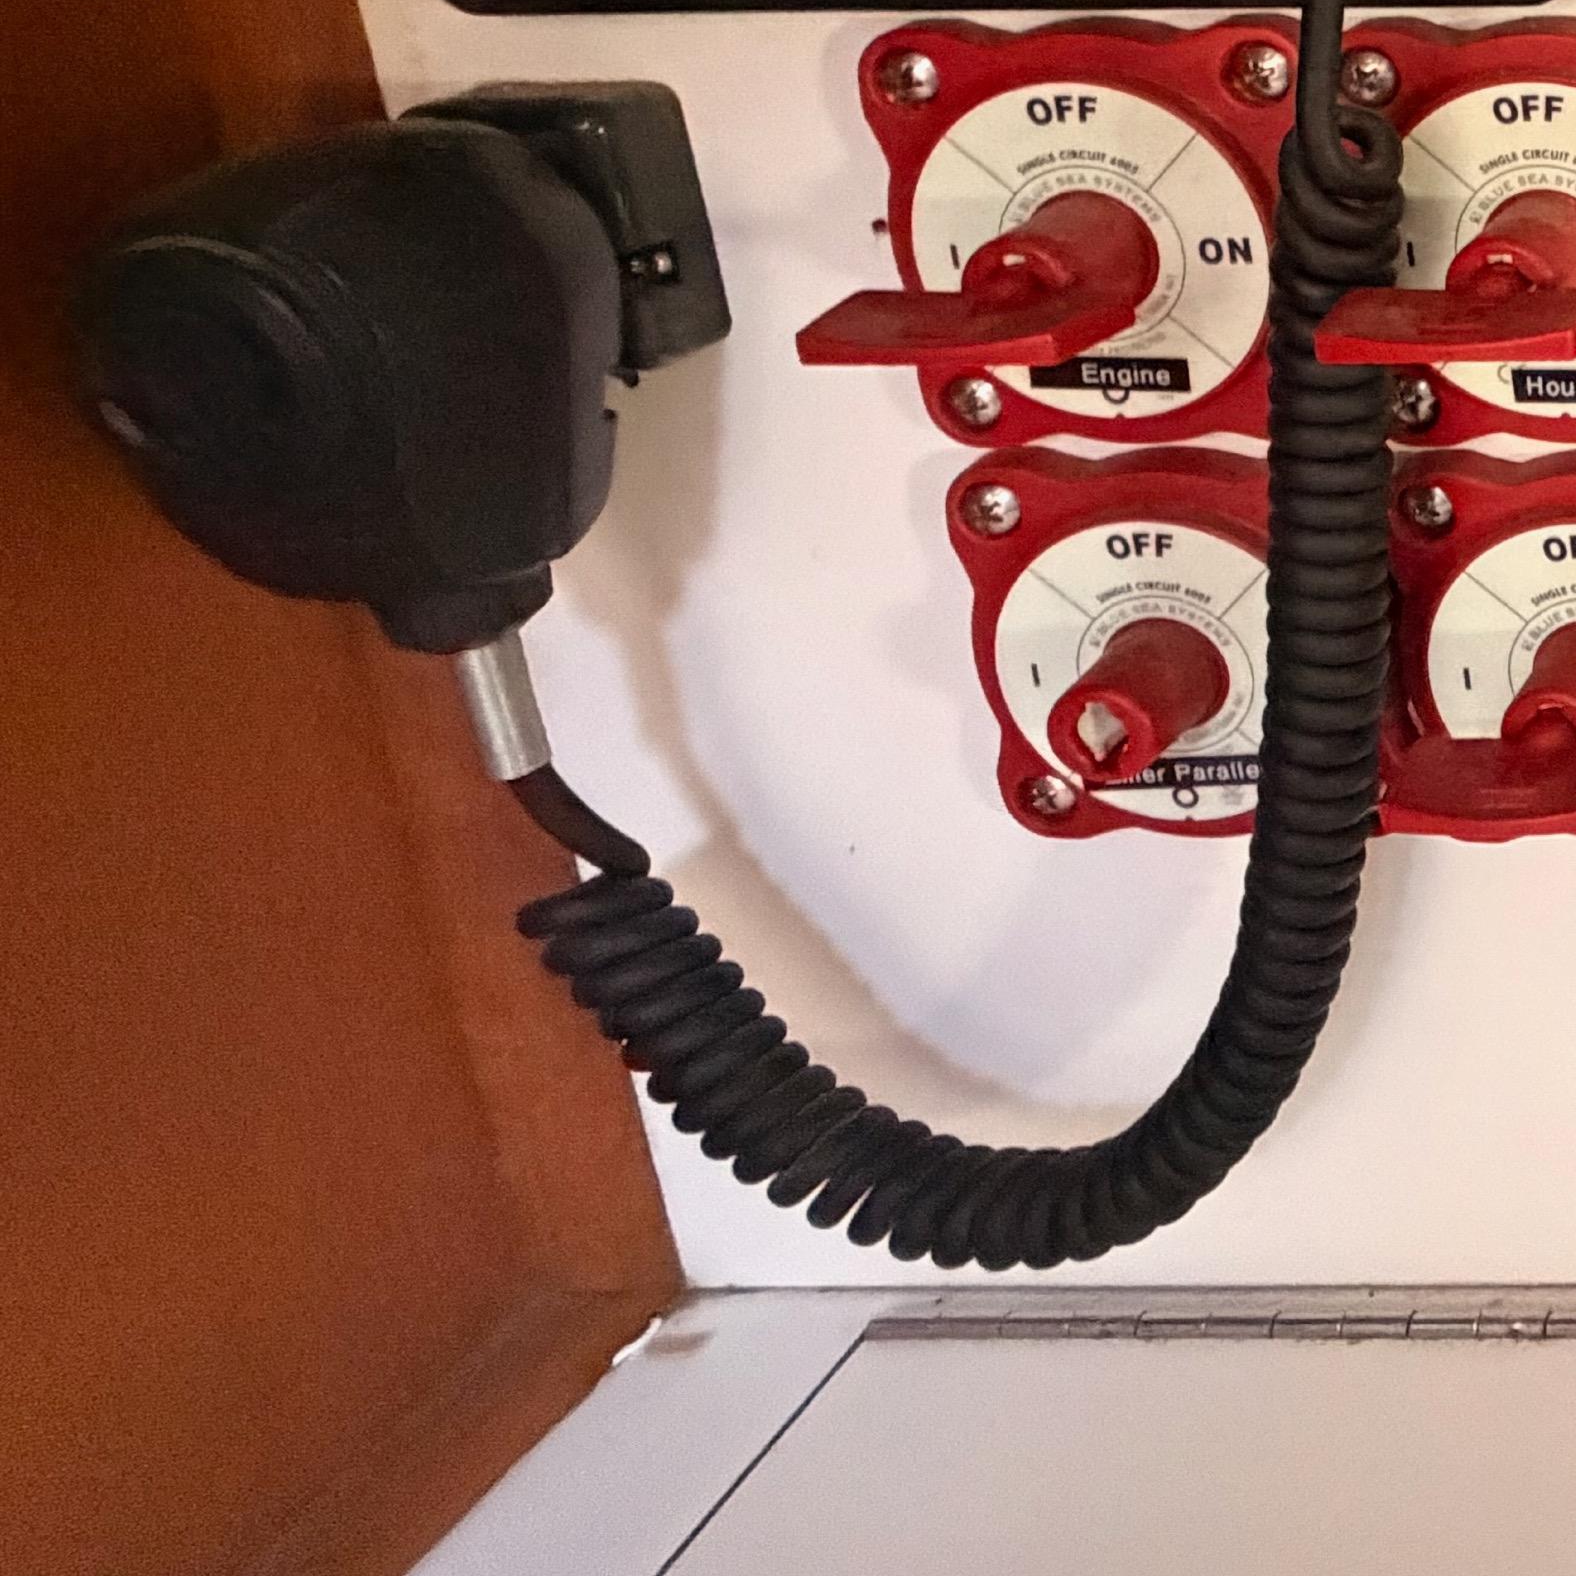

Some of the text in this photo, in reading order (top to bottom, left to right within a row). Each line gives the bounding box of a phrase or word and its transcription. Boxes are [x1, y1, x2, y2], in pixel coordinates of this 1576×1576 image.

[1026, 95, 1097, 126] OFF
[1493, 95, 1564, 125] OFF
[1478, 150, 1519, 174] SINGLE
[1522, 148, 1570, 163] CIRCUIT
[1198, 237, 1253, 265] ON
[1080, 362, 1170, 387] Engine
[1106, 533, 1174, 560] OFF
